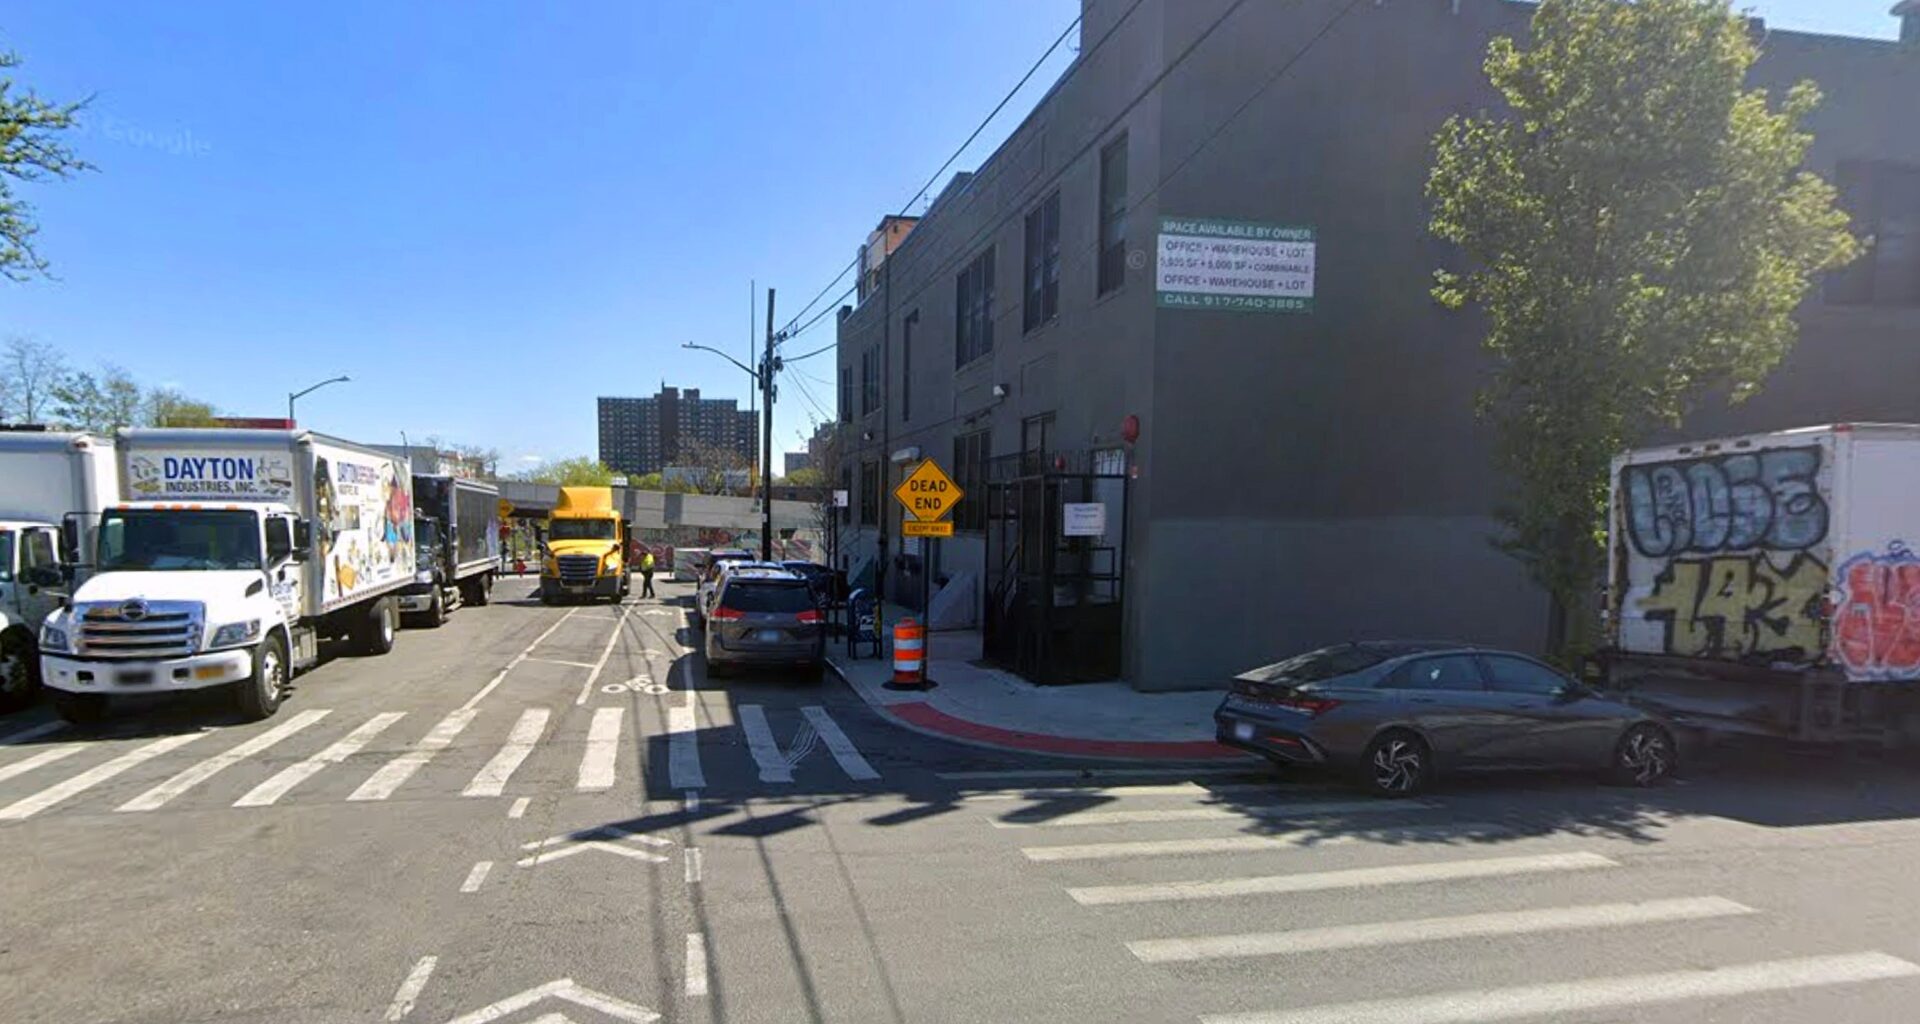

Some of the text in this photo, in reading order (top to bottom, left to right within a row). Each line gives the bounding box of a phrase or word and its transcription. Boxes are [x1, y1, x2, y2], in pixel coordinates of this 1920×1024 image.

[1162, 221, 1312, 241] SPACE AVAILABLE BY OWNER
[1165, 240, 1307, 258] OFFICE WAREHOUSE LOT
[1253, 263, 1309, 274] COMBINABLE
[1163, 274, 1306, 290] OFFICE WAREHOUSE LOT
[1163, 293, 1199, 305] CALL
[164, 458, 254, 479] DAYTON
[165, 481, 258, 495] INDUSTRIES, INC.
[909, 479, 948, 492] DEAD
[914, 497, 942, 510] END
